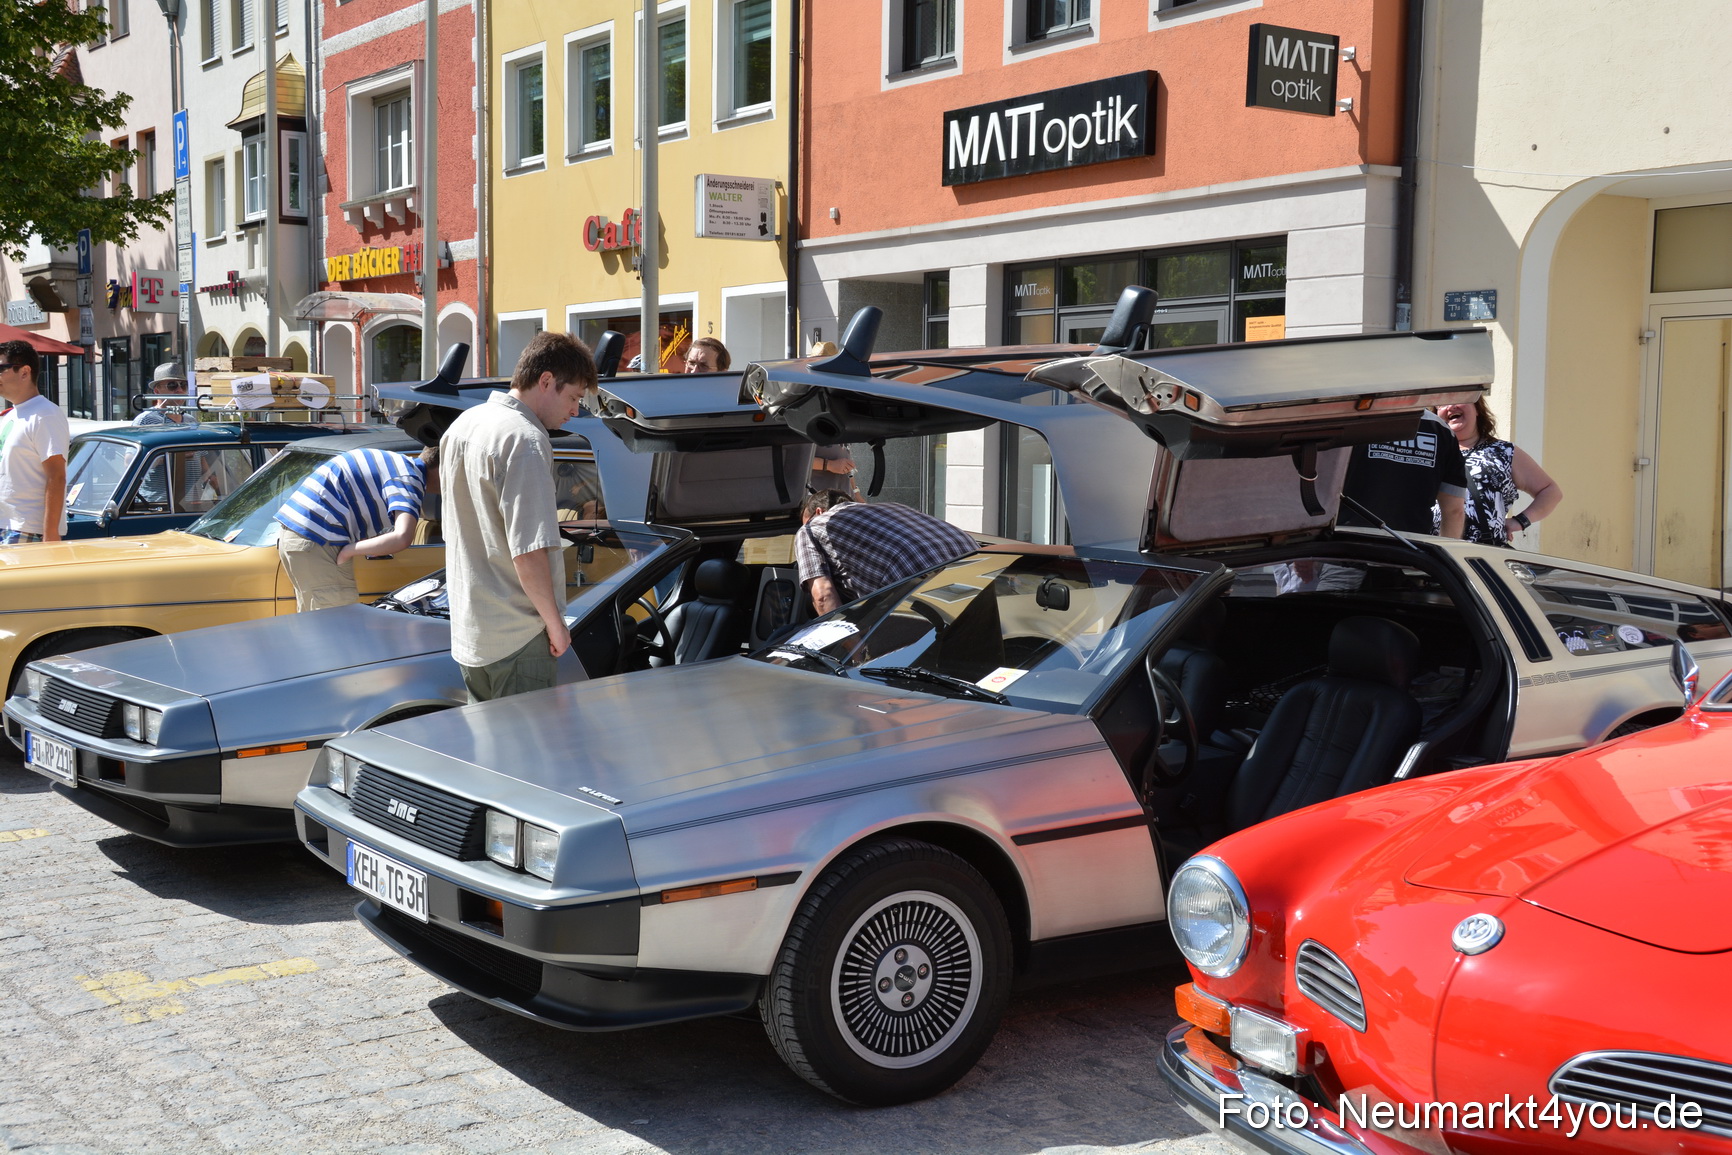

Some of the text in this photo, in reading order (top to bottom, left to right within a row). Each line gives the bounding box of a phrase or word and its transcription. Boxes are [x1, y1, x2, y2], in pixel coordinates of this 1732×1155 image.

[1265, 35, 1335, 74] MATT
[1271, 79, 1321, 102] optik
[176, 120, 184, 170] P
[707, 176, 755, 191] Änderungsschneiderei
[709, 192, 743, 202] WALTER
[80, 235, 87, 269] P
[328, 254, 350, 282] DER
[353, 246, 400, 279] BÄCKER
[1396, 447, 1413, 455] MOTOR
[1414, 450, 1434, 458] COMPANY
[45, 741, 55, 767] RP
[387, 798, 419, 824] DMC
[354, 849, 425, 915] KEH TG 3H
